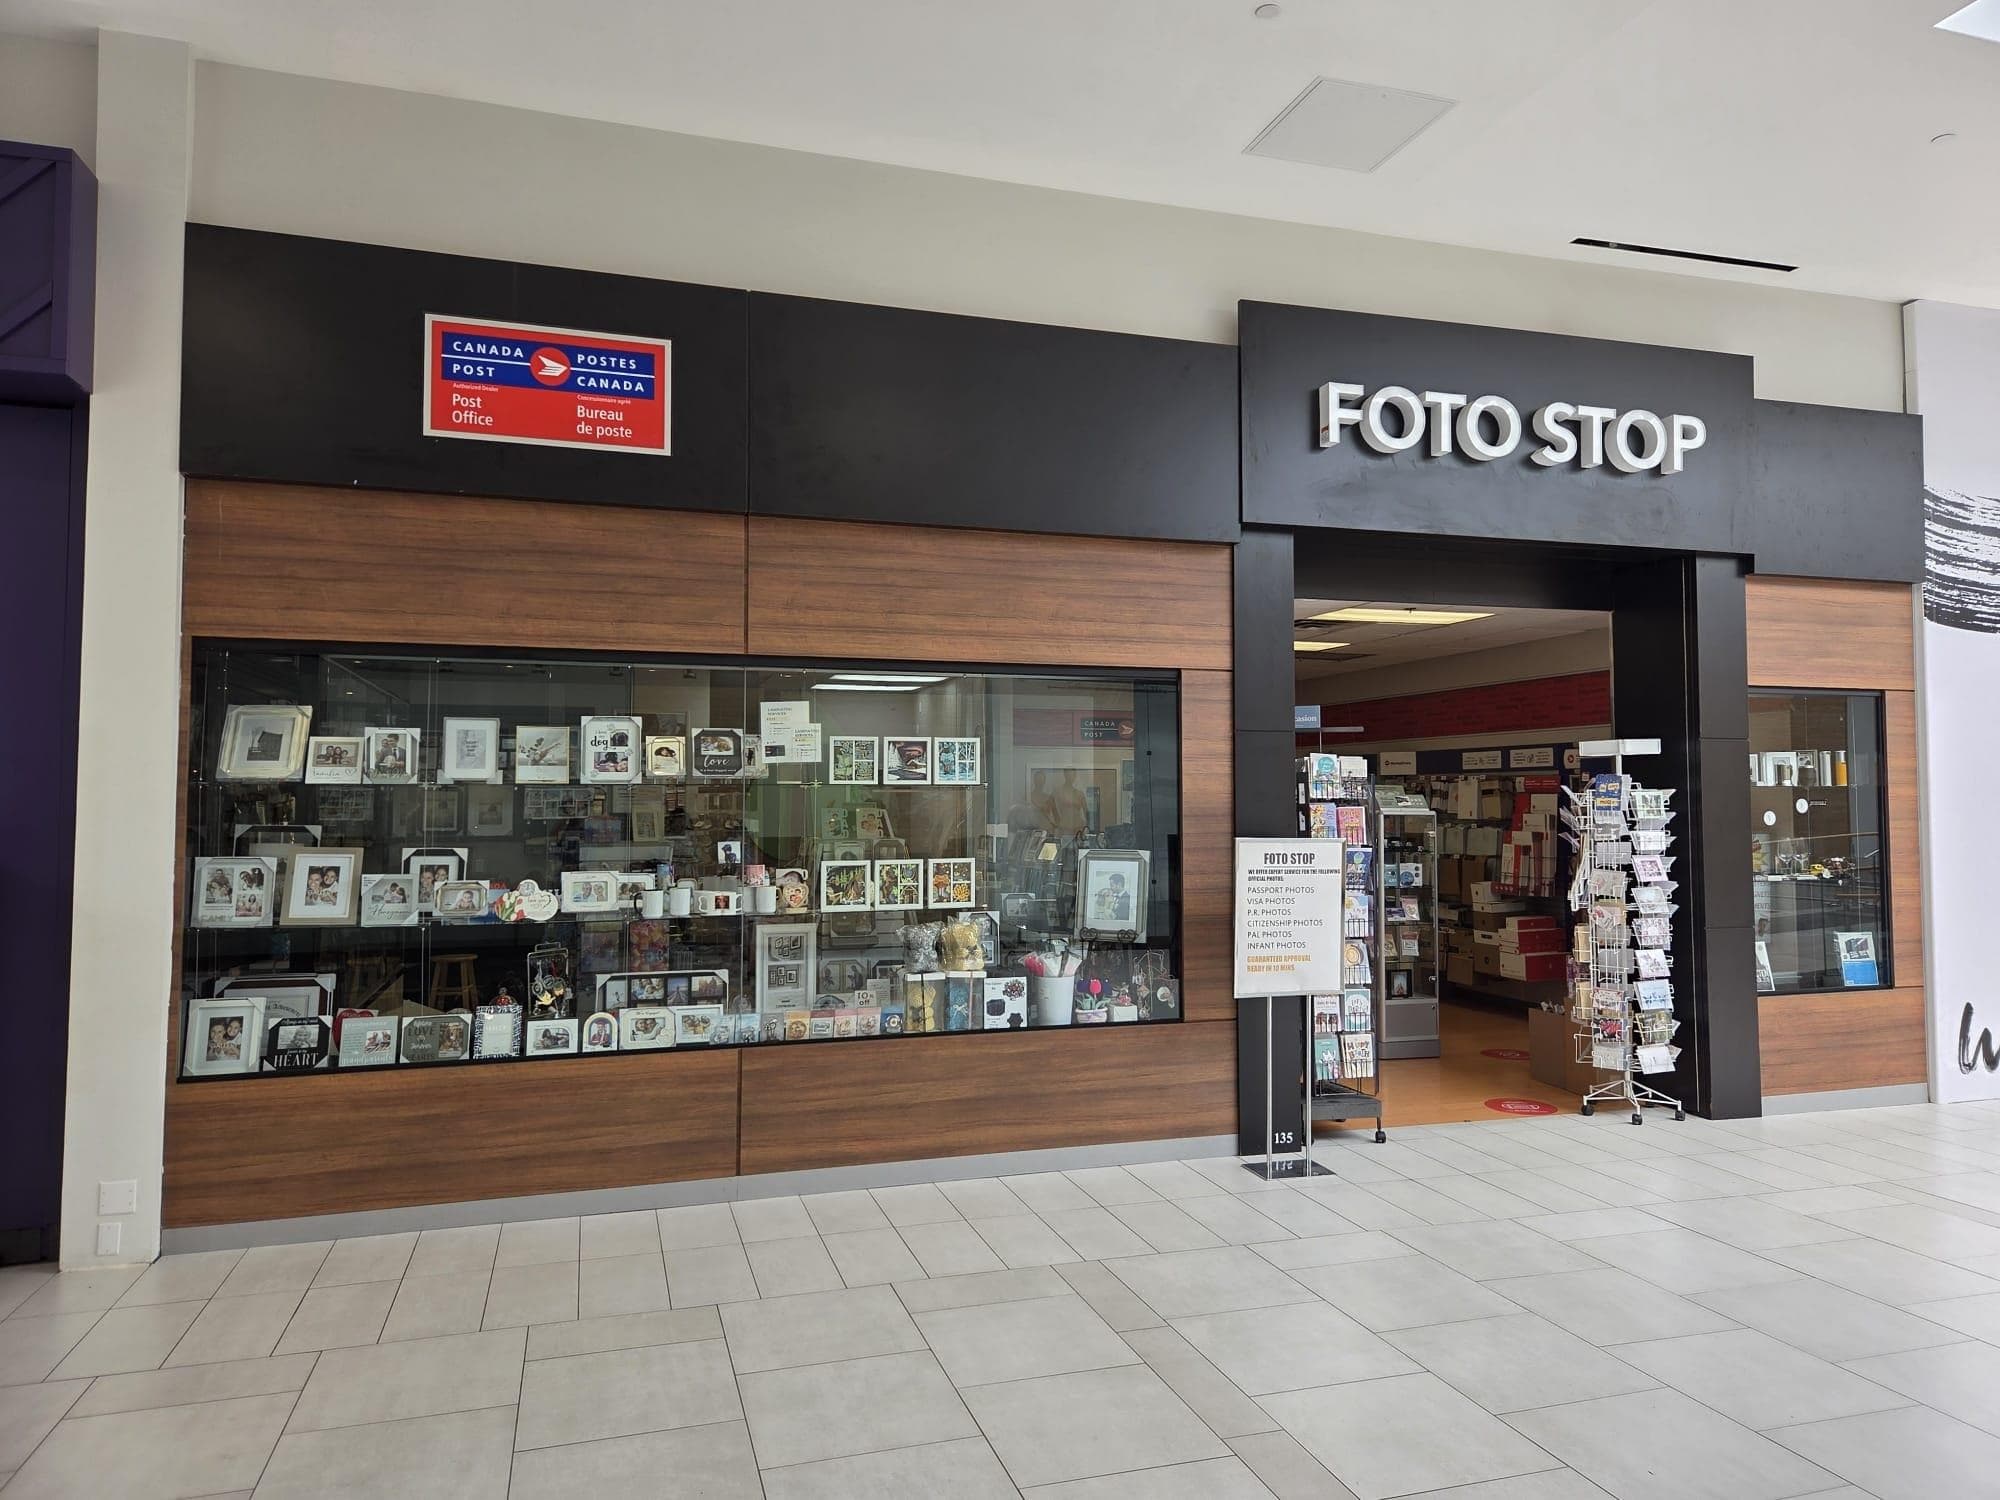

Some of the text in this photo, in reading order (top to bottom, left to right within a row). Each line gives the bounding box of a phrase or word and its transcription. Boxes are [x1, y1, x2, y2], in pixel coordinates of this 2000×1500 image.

[453, 341, 524, 358] CANADA
[577, 354, 637, 369] POSTES
[452, 363, 495, 377] POST
[576, 376, 645, 393] CANADA
[452, 393, 482, 408] Post
[452, 410, 494, 426] Office
[577, 405, 623, 421] Bureau
[576, 421, 632, 439] de poste
[1319, 382, 1707, 475] FOTO STOP
[591, 736, 616, 750] dog
[704, 755, 729, 767] love
[1264, 853, 1315, 865] FOTO STOP
[1248, 886, 1315, 894] PASSPORT PHOTOS
[1247, 897, 1296, 905] VISA PHOTOS
[1261, 908, 1292, 916] PHOTOS
[1293, 919, 1323, 927] PHOTOS
[1248, 941, 1307, 950] INFANT PHOTOS
[1247, 954, 1312, 963] GUARANTEED APPROVAL
[274, 1053, 319, 1067] HEART
[1274, 1132, 1293, 1144] 135
